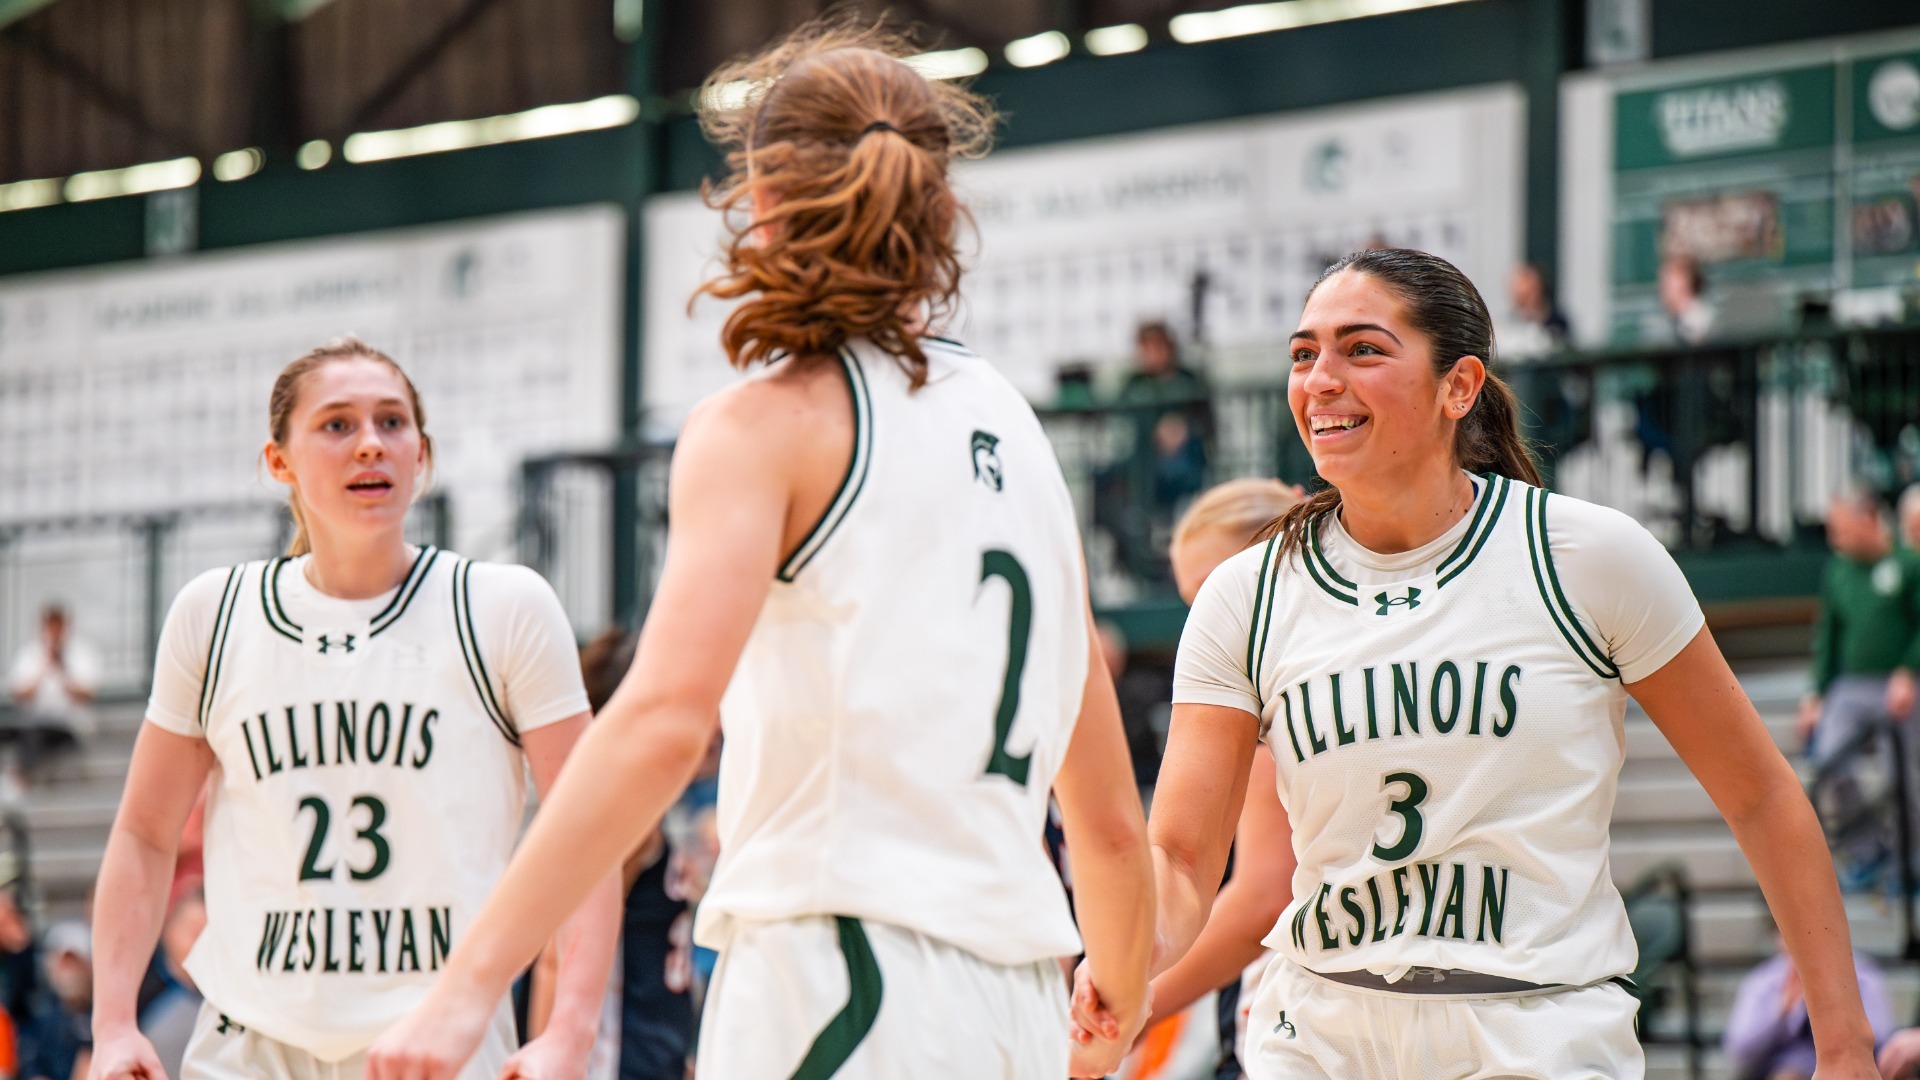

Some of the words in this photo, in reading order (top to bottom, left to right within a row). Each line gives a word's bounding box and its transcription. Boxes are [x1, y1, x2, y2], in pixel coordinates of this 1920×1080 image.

[979, 549, 1033, 787] 2
[1280, 660, 1522, 763] ILLINOIS
[241, 701, 439, 781] ILLINOIS
[297, 794, 391, 882] 23
[1371, 771, 1428, 862] 3
[256, 907, 452, 973] WESLEYAN
[1290, 863, 1509, 951] WESLEYAN
